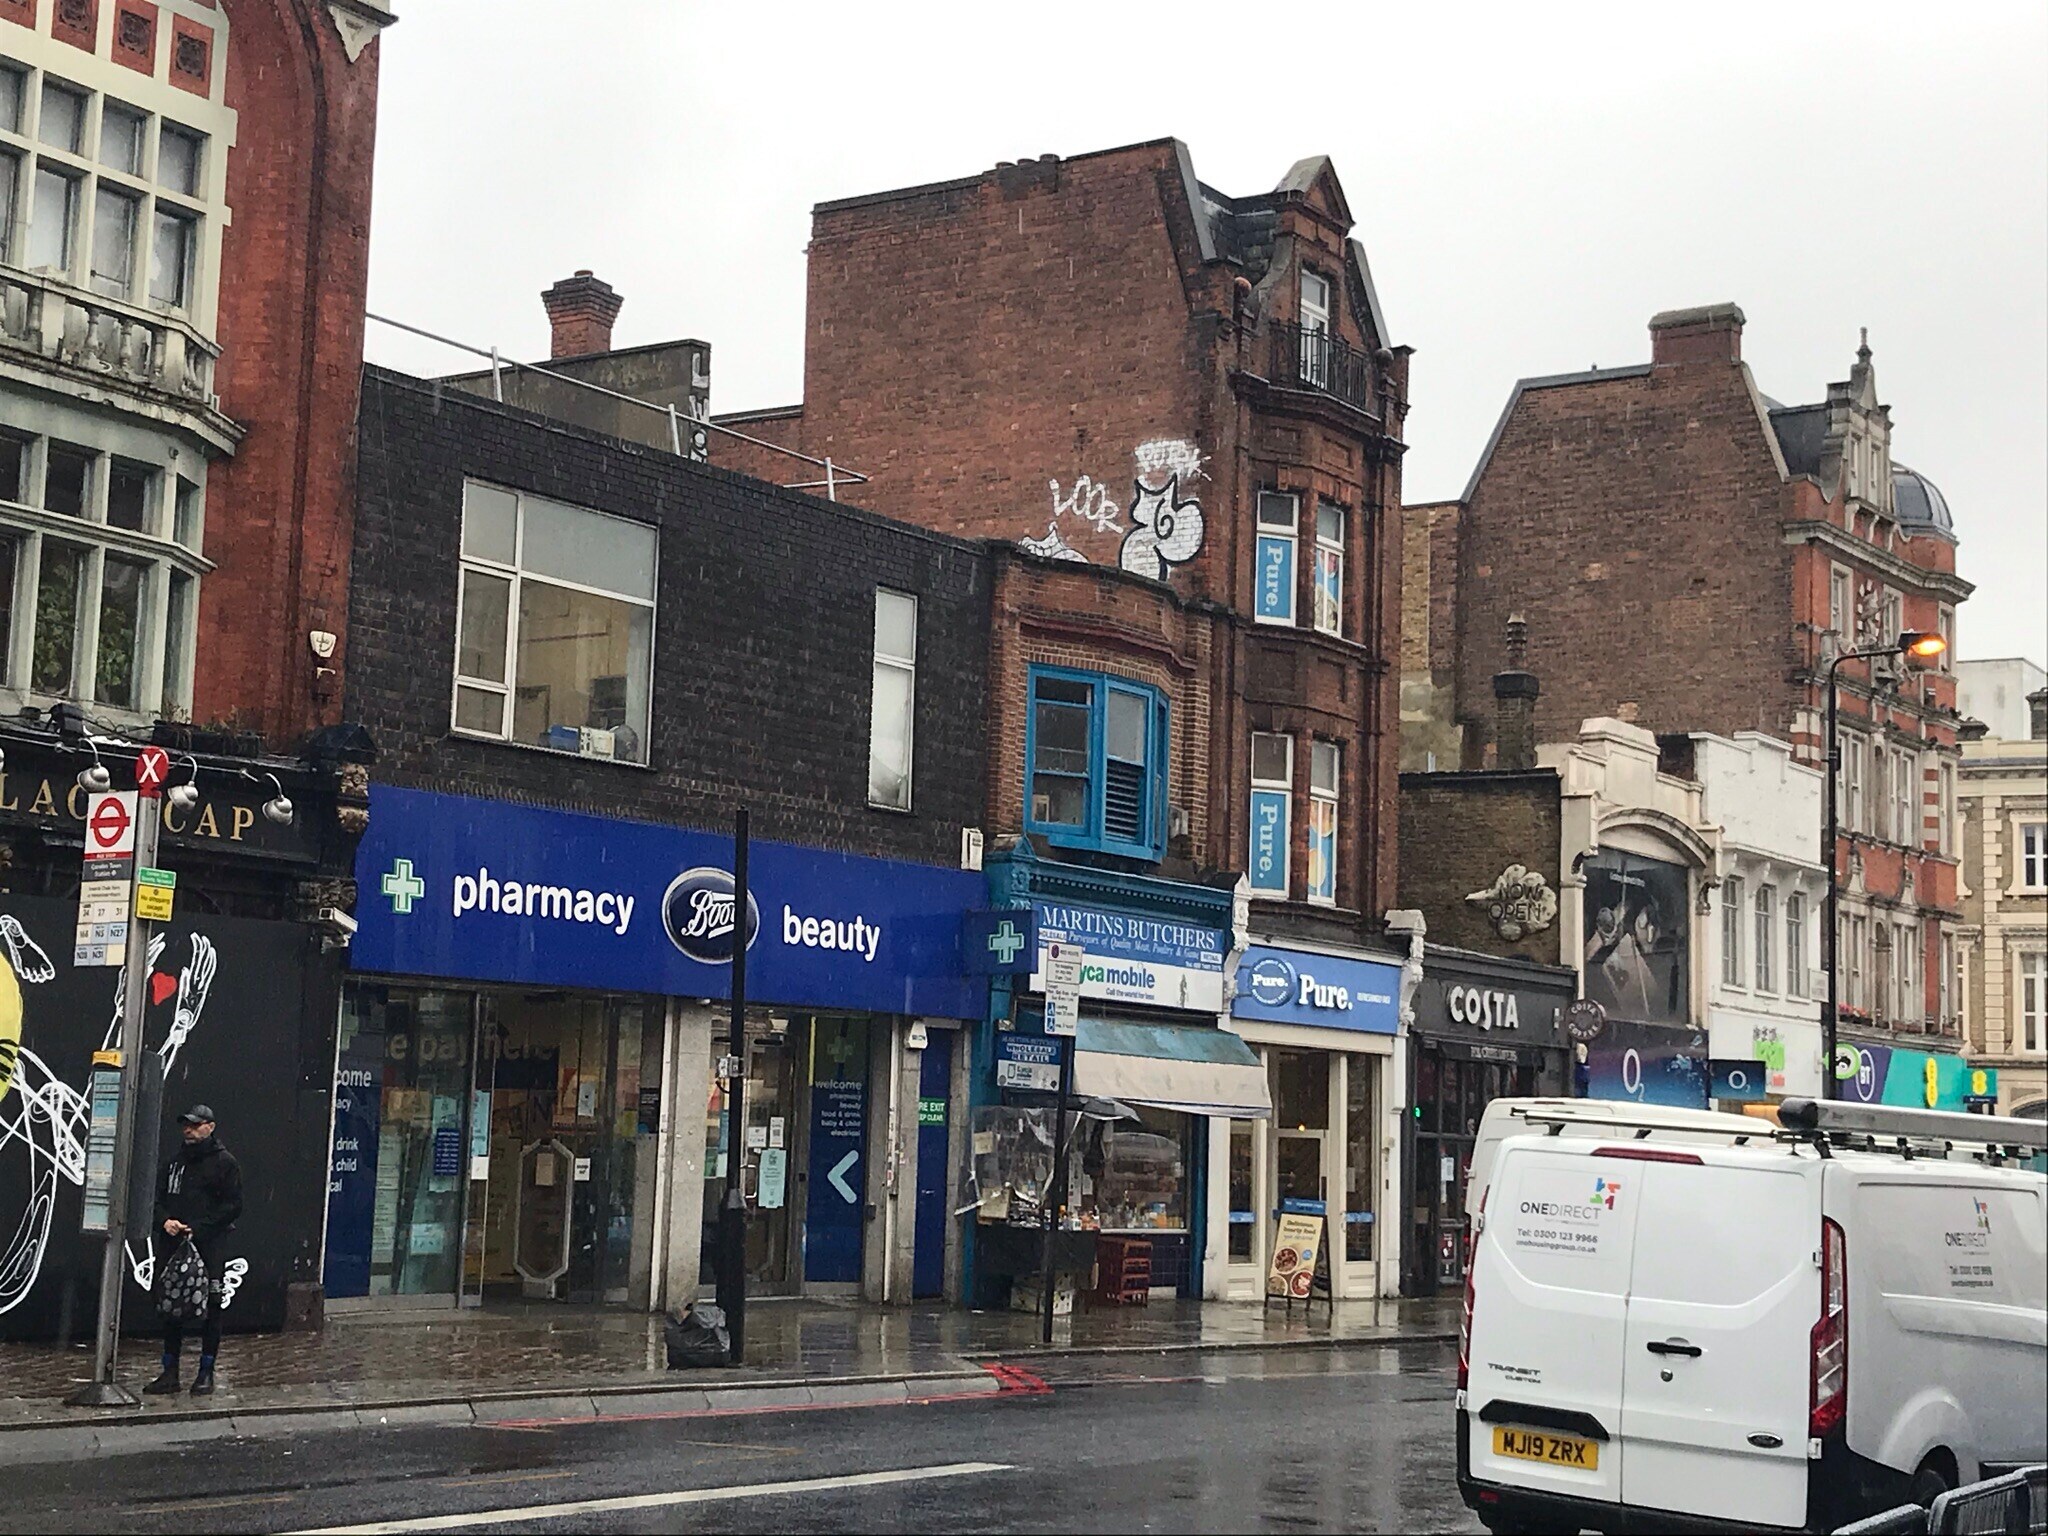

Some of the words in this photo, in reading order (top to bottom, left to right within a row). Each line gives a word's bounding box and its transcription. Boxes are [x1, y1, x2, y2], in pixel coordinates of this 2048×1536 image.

[1265, 545, 1284, 613] Pure.
[139, 752, 161, 784] X
[164, 799, 254, 841] CAP
[1258, 803, 1278, 880] Pure.
[453, 867, 635, 935] pharmacy
[1501, 883, 1541, 901] NOW
[98, 907, 105, 916] 27
[1489, 902, 1541, 921] OPEN
[110, 928, 124, 937] N27
[783, 904, 881, 962] beauty
[1042, 905, 1124, 937] MARTINS
[1127, 918, 1216, 951] BUTCHERS
[1252, 974, 1289, 987] Pure.
[1299, 974, 1353, 1011] Pure.
[1450, 986, 1519, 1031] COSTA
[1007, 1045, 1055, 1054] WHOLESALE
[1012, 1053, 1049, 1062] RETAIL
[1860, 1065, 1872, 1085] BT
[815, 1079, 862, 1090] welcome
[930, 1102, 945, 1112] EXIT
[337, 1137, 360, 1151] drink
[336, 1158, 358, 1172] child
[1517, 1228, 1532, 1237] Tel:
[1533, 1229, 1557, 1239] 0300
[1559, 1231, 1573, 1241] 123
[1487, 1362, 1541, 1376] TRANSIT
[1505, 1374, 1541, 1383] CUSTOM
[1503, 1432, 1545, 1457] MJ19
[1548, 1440, 1586, 1465] ZRX
